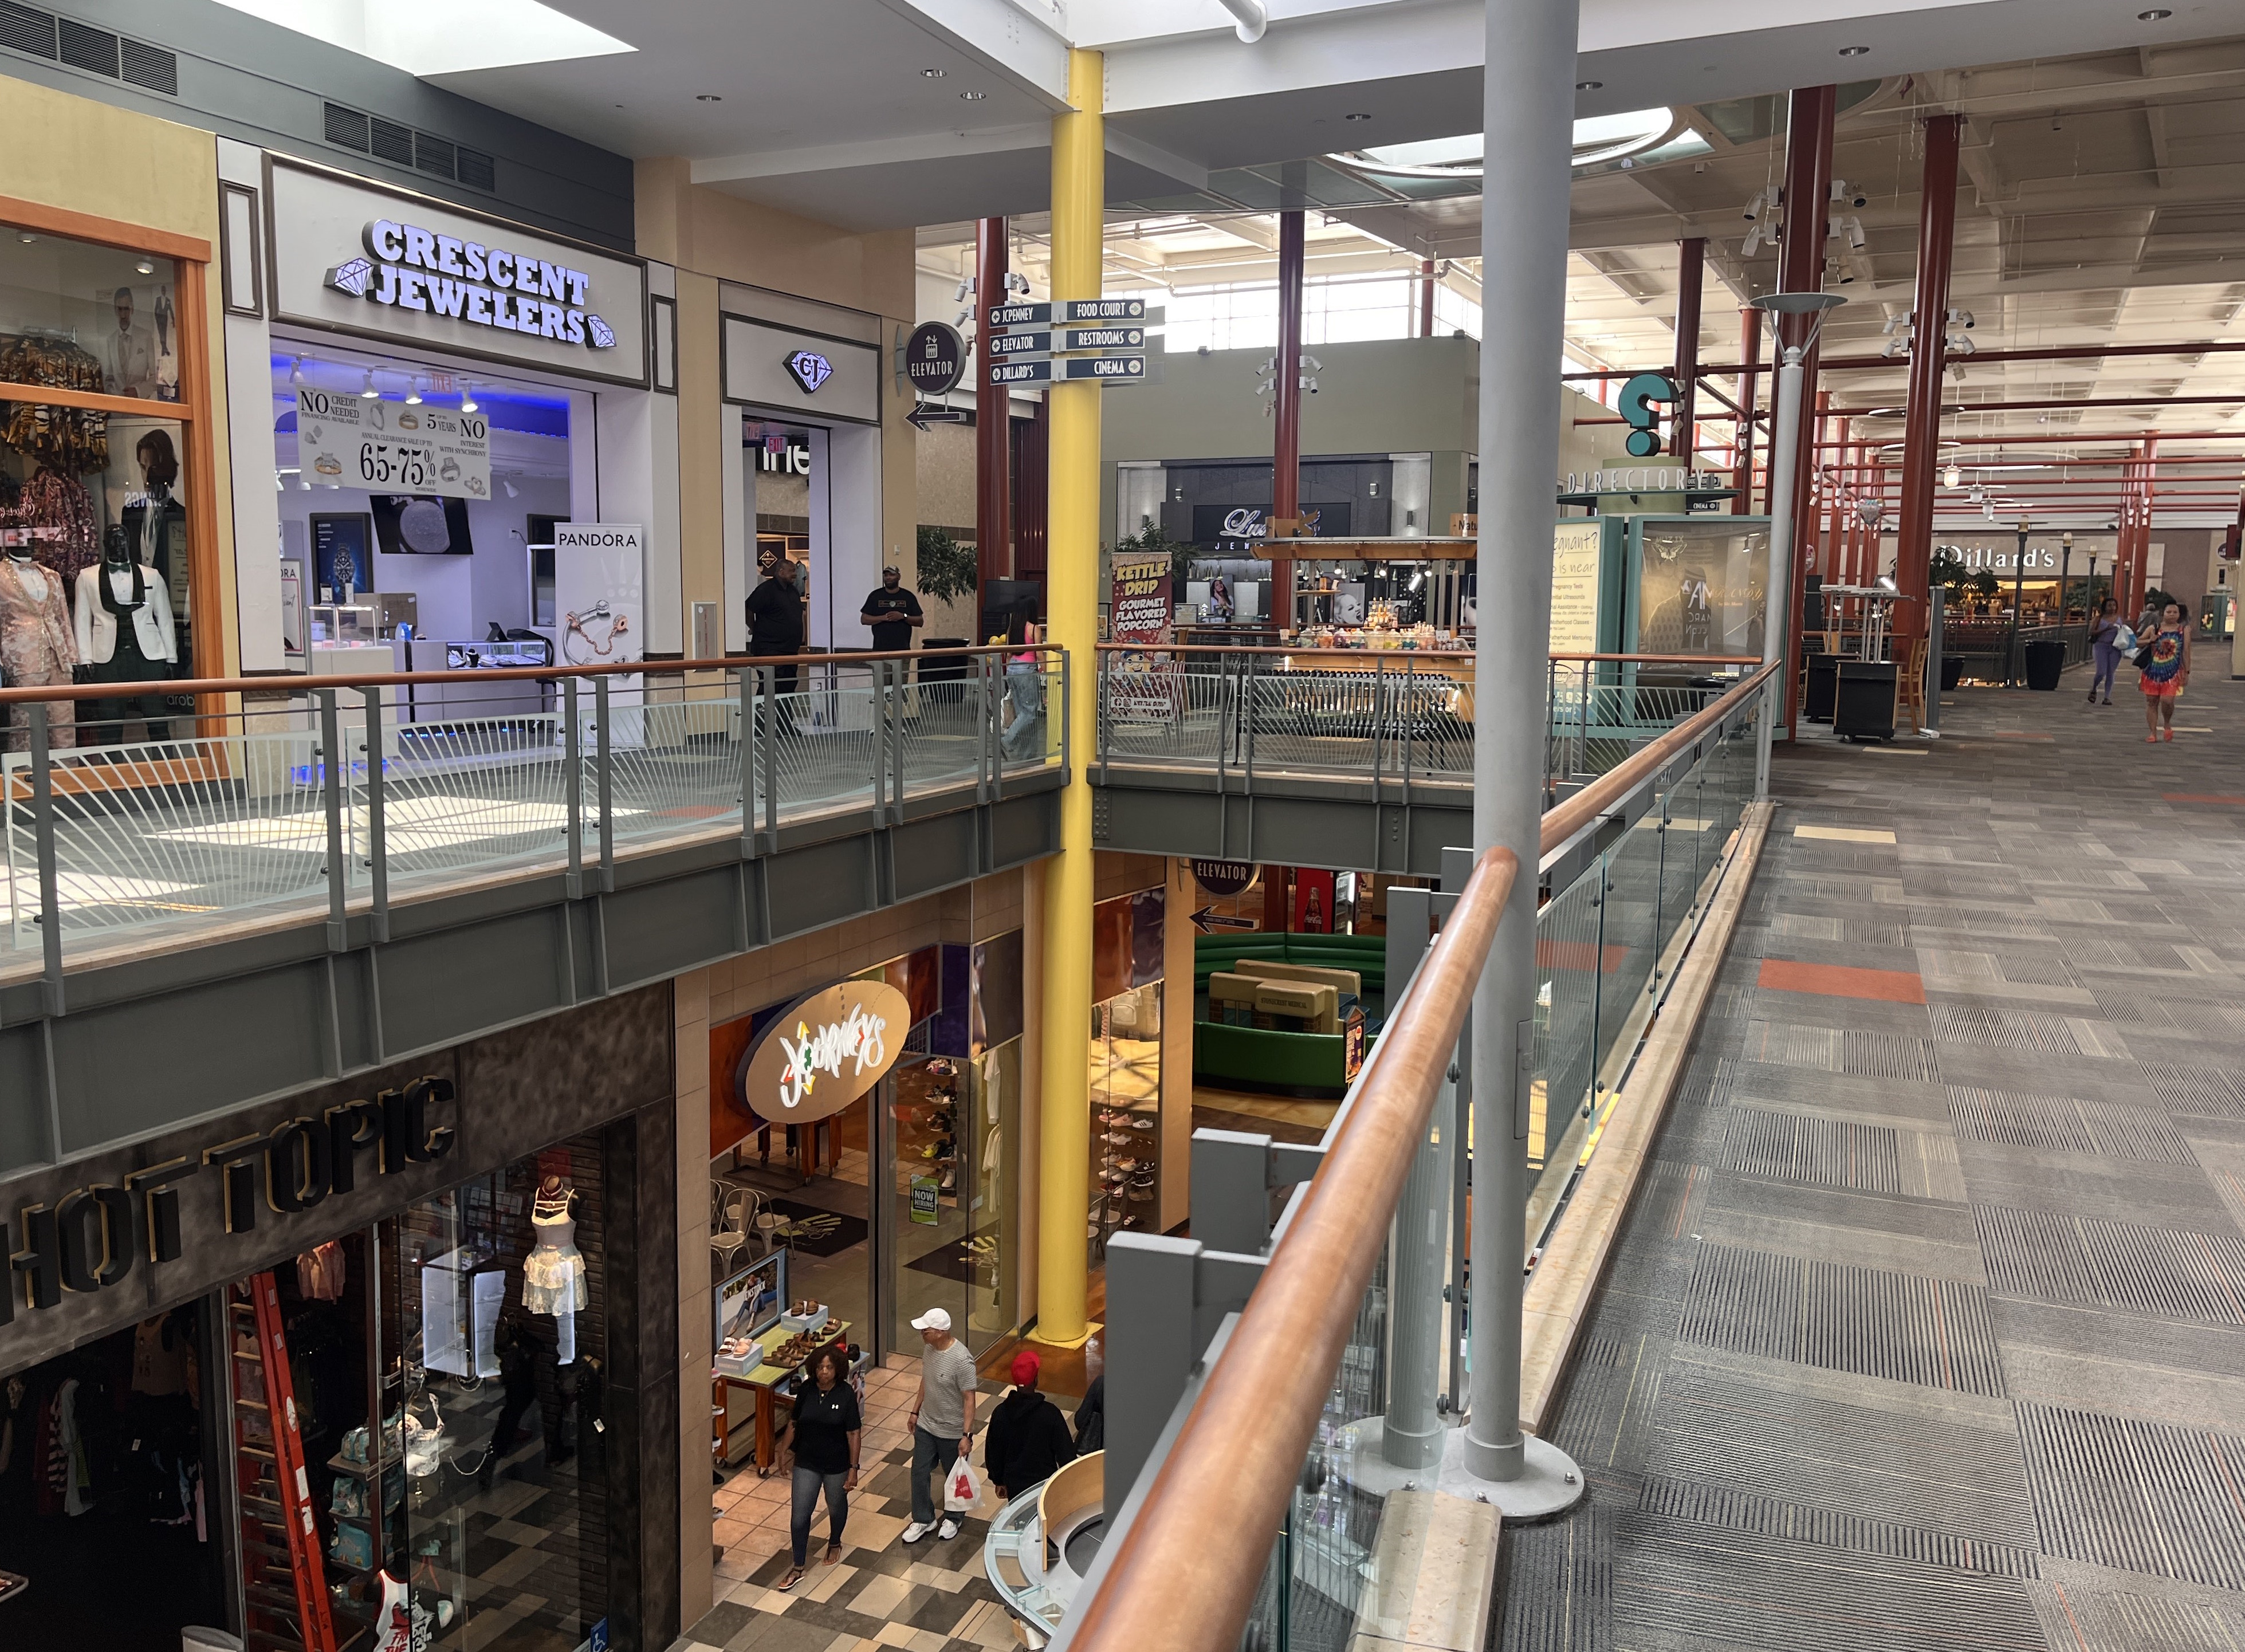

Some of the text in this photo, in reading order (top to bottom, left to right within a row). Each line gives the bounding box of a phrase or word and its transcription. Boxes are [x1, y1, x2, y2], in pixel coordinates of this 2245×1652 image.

[371, 219, 589, 306] CRESCENT
[375, 263, 585, 344] JEWELERS
[1077, 302, 1125, 317] FOOD COURT
[1002, 307, 1033, 322] JCPENNEY
[1002, 336, 1033, 352] ELEVATOR
[1078, 331, 1125, 346] RESTROOMS
[799, 357, 819, 383] CJ
[911, 361, 953, 377] ELEVATOR
[1002, 365, 1033, 380] DILLARD'S
[1094, 360, 1125, 375] CINEMA
[300, 391, 357, 414] NO CREDIT
[330, 406, 360, 419] NEEDED
[331, 416, 359, 426] AVAILABLE
[427, 414, 436, 429] 5
[438, 420, 456, 432] YEARS
[459, 418, 485, 439] NO
[361, 432, 380, 440] ANNUAL
[407, 437, 420, 445] SALE
[460, 440, 485, 449] INTEREST
[769, 438, 783, 452] EXIT
[454, 447, 486, 457] SYNCHRONY
[360, 443, 435, 485] 65-75%
[1568, 468, 1705, 493] DIRECTORY
[559, 533, 637, 547] PANDORA
[1554, 532, 1597, 558] egnant?
[1116, 561, 1167, 581] KETTLE
[1570, 564, 1595, 573] near
[1125, 579, 1158, 596] DRIP
[1119, 597, 1165, 611] GOURMET
[1115, 607, 1167, 622] FLAVORED
[1117, 619, 1163, 631] POPCORN
[1197, 862, 1246, 881] ELEVATOR
[0, 1075, 455, 1327] HOT TOPIC
[914, 1190, 934, 1202] NOW
[914, 1199, 934, 1208] HIRING
